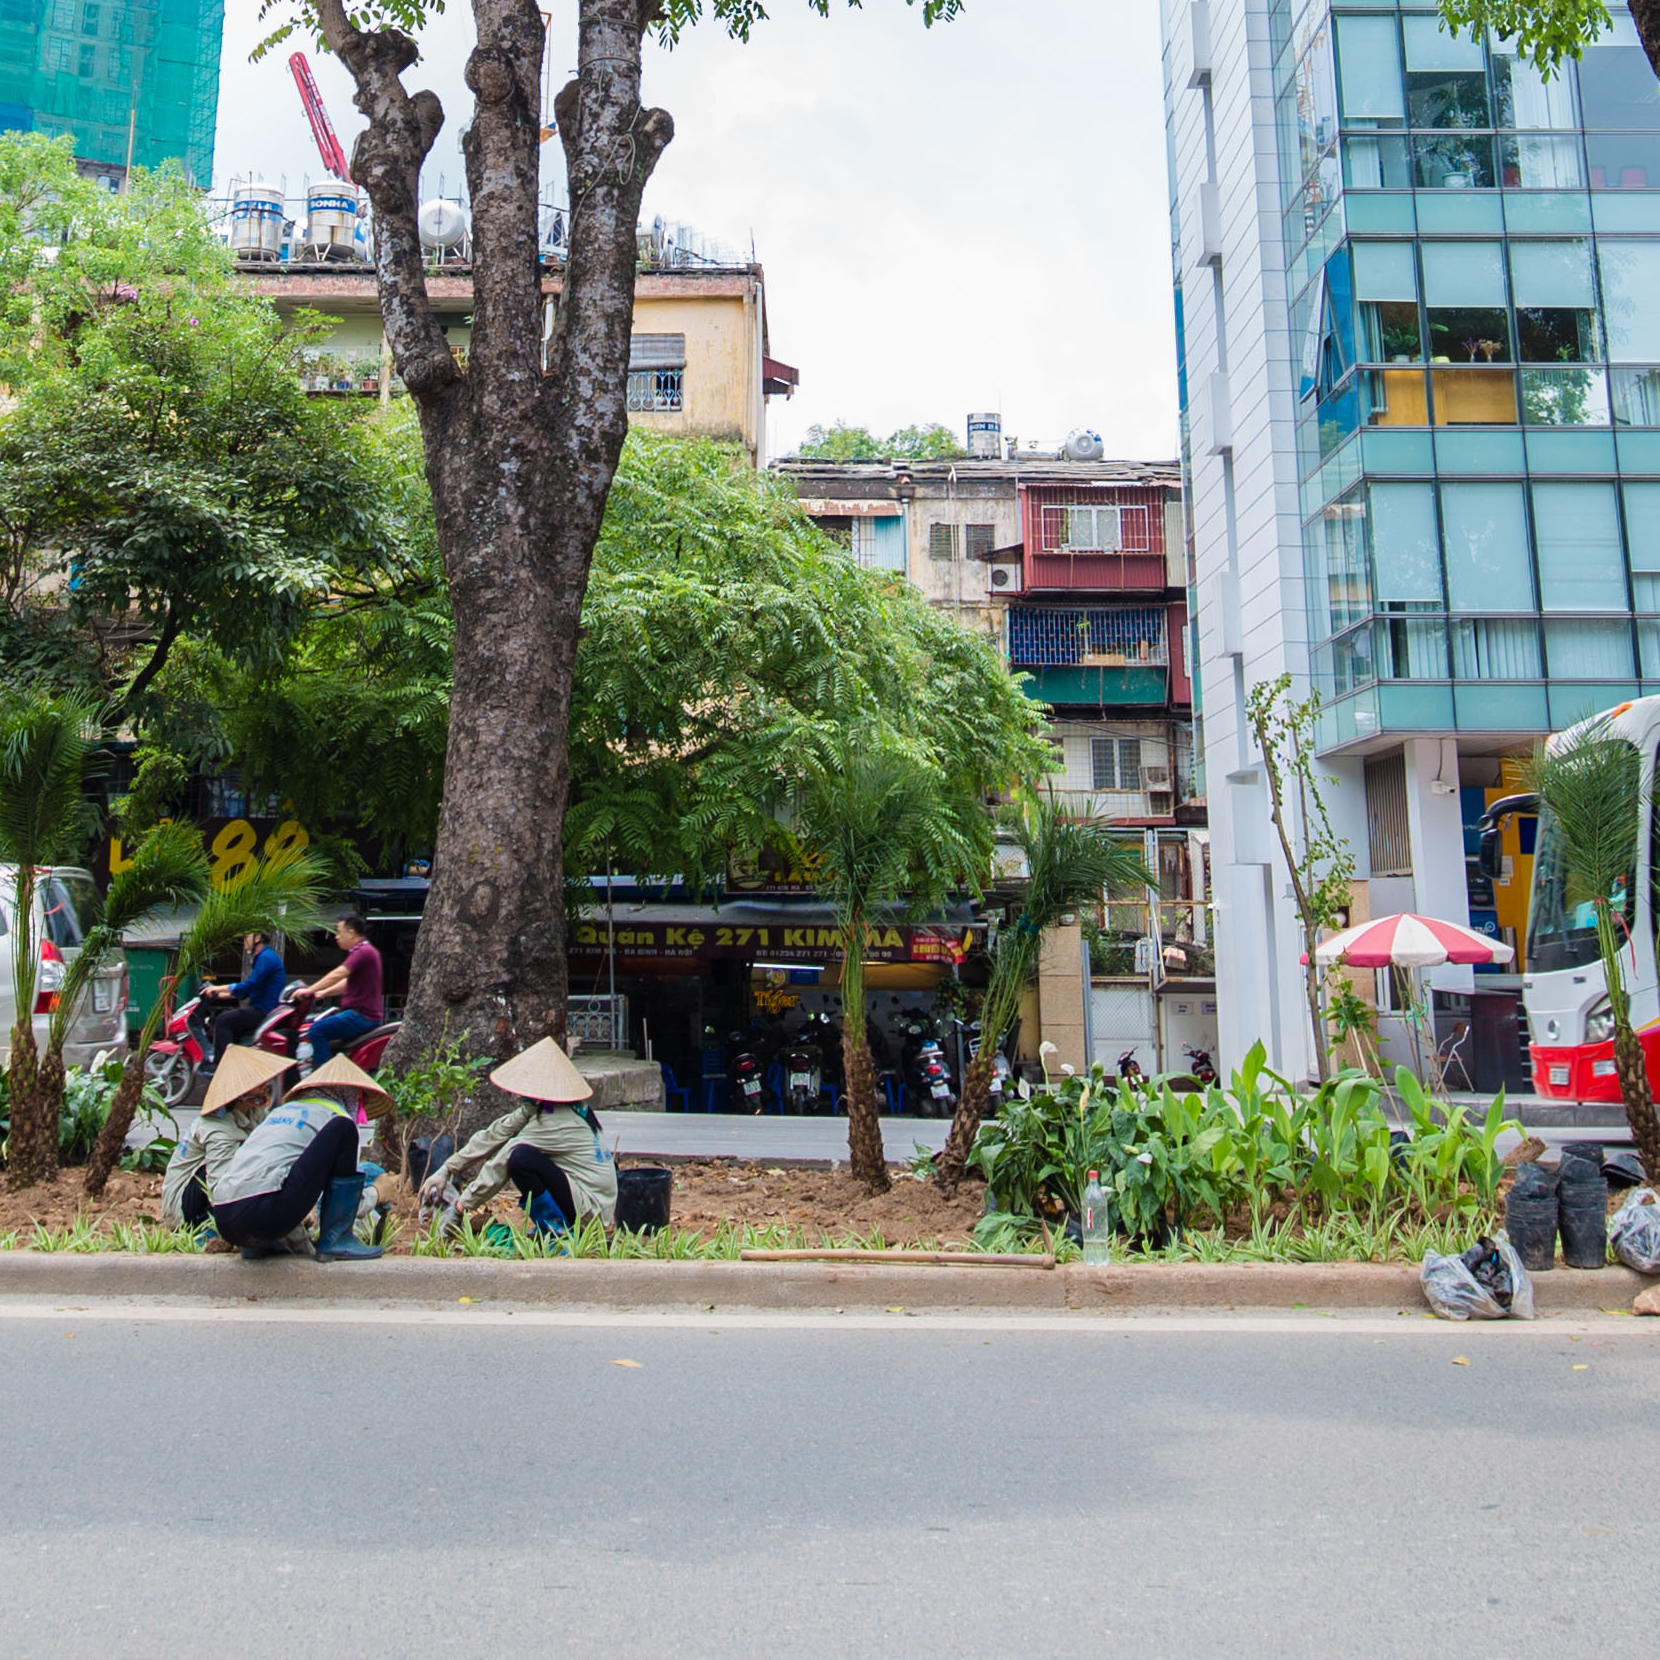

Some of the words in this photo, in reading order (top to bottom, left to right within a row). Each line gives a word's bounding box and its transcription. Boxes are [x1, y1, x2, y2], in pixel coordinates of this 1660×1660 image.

[578, 926, 655, 945] Quán
[666, 928, 705, 950] Kệ
[715, 928, 770, 946] 271
[754, 990, 800, 1014] Tiger
